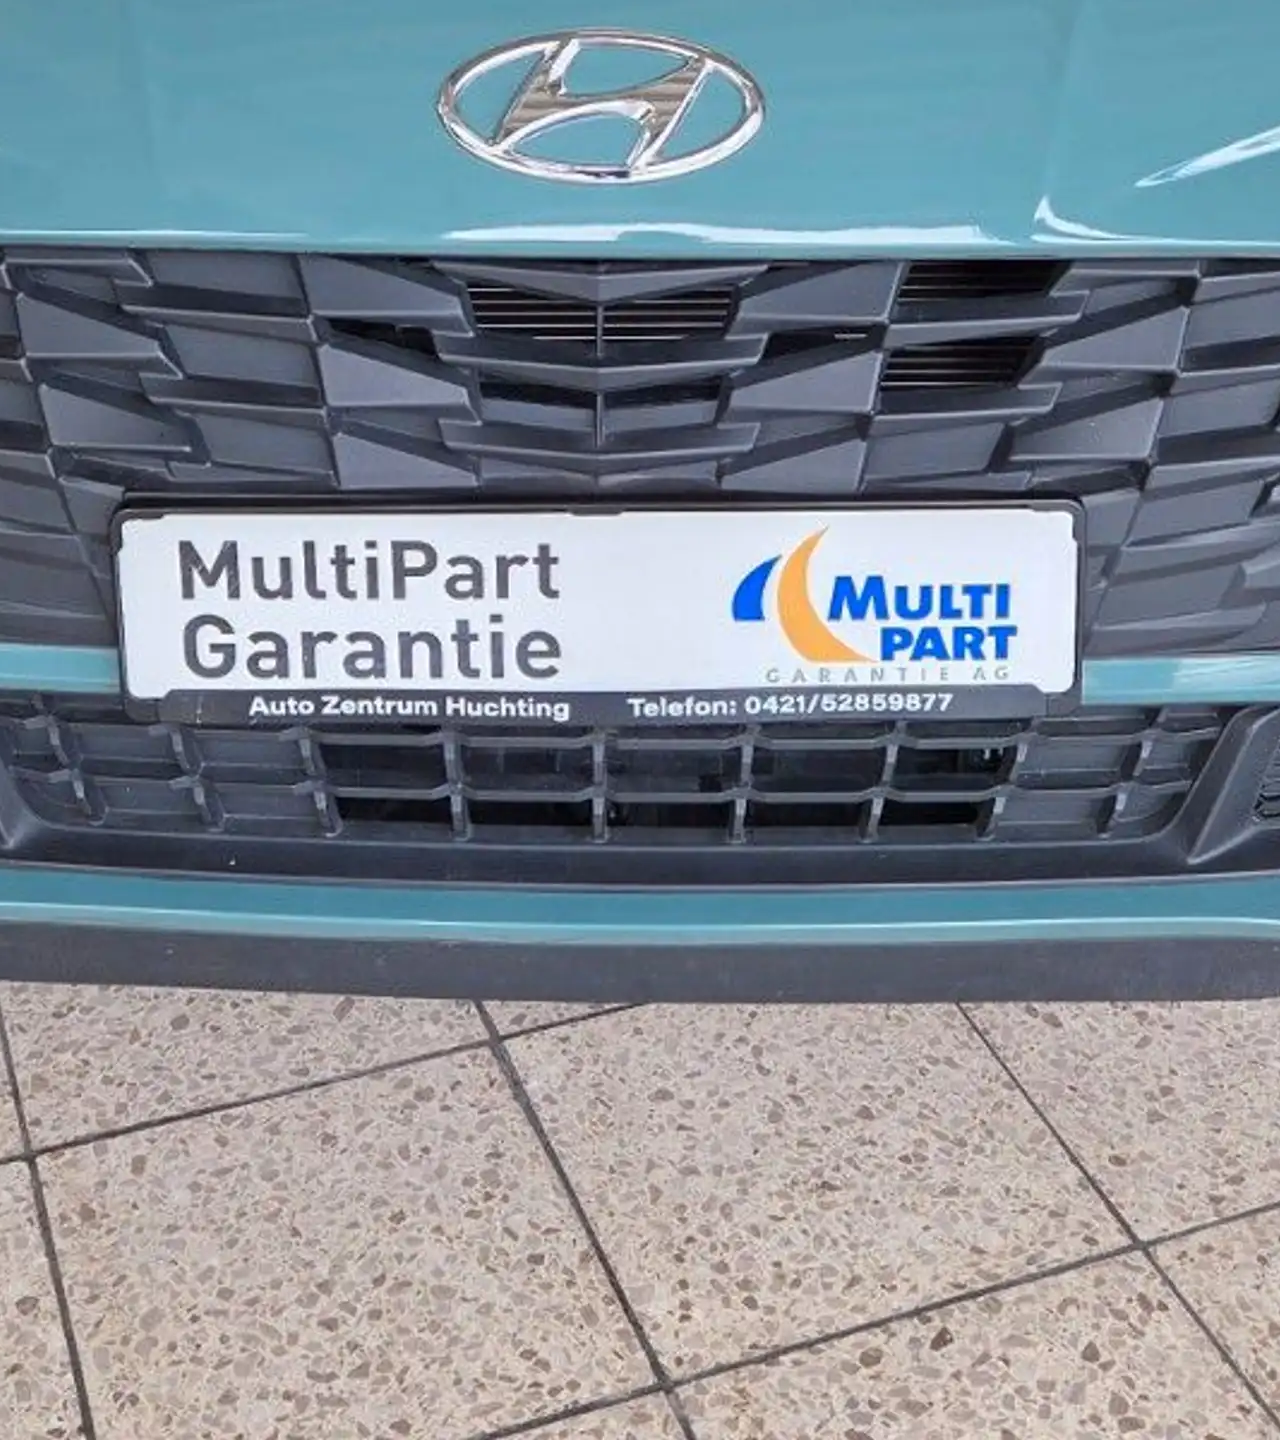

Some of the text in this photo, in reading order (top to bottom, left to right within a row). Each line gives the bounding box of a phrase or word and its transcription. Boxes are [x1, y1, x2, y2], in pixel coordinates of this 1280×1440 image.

[178, 540, 560, 601] MultiPart
[182, 614, 562, 680] Garantie
[879, 623, 1019, 663] PART
[765, 664, 1011, 684] GARANTIE AG
[248, 694, 570, 722] Auto Zentrum Huchting
[626, 692, 955, 718] Telefon: 0421/52859877
